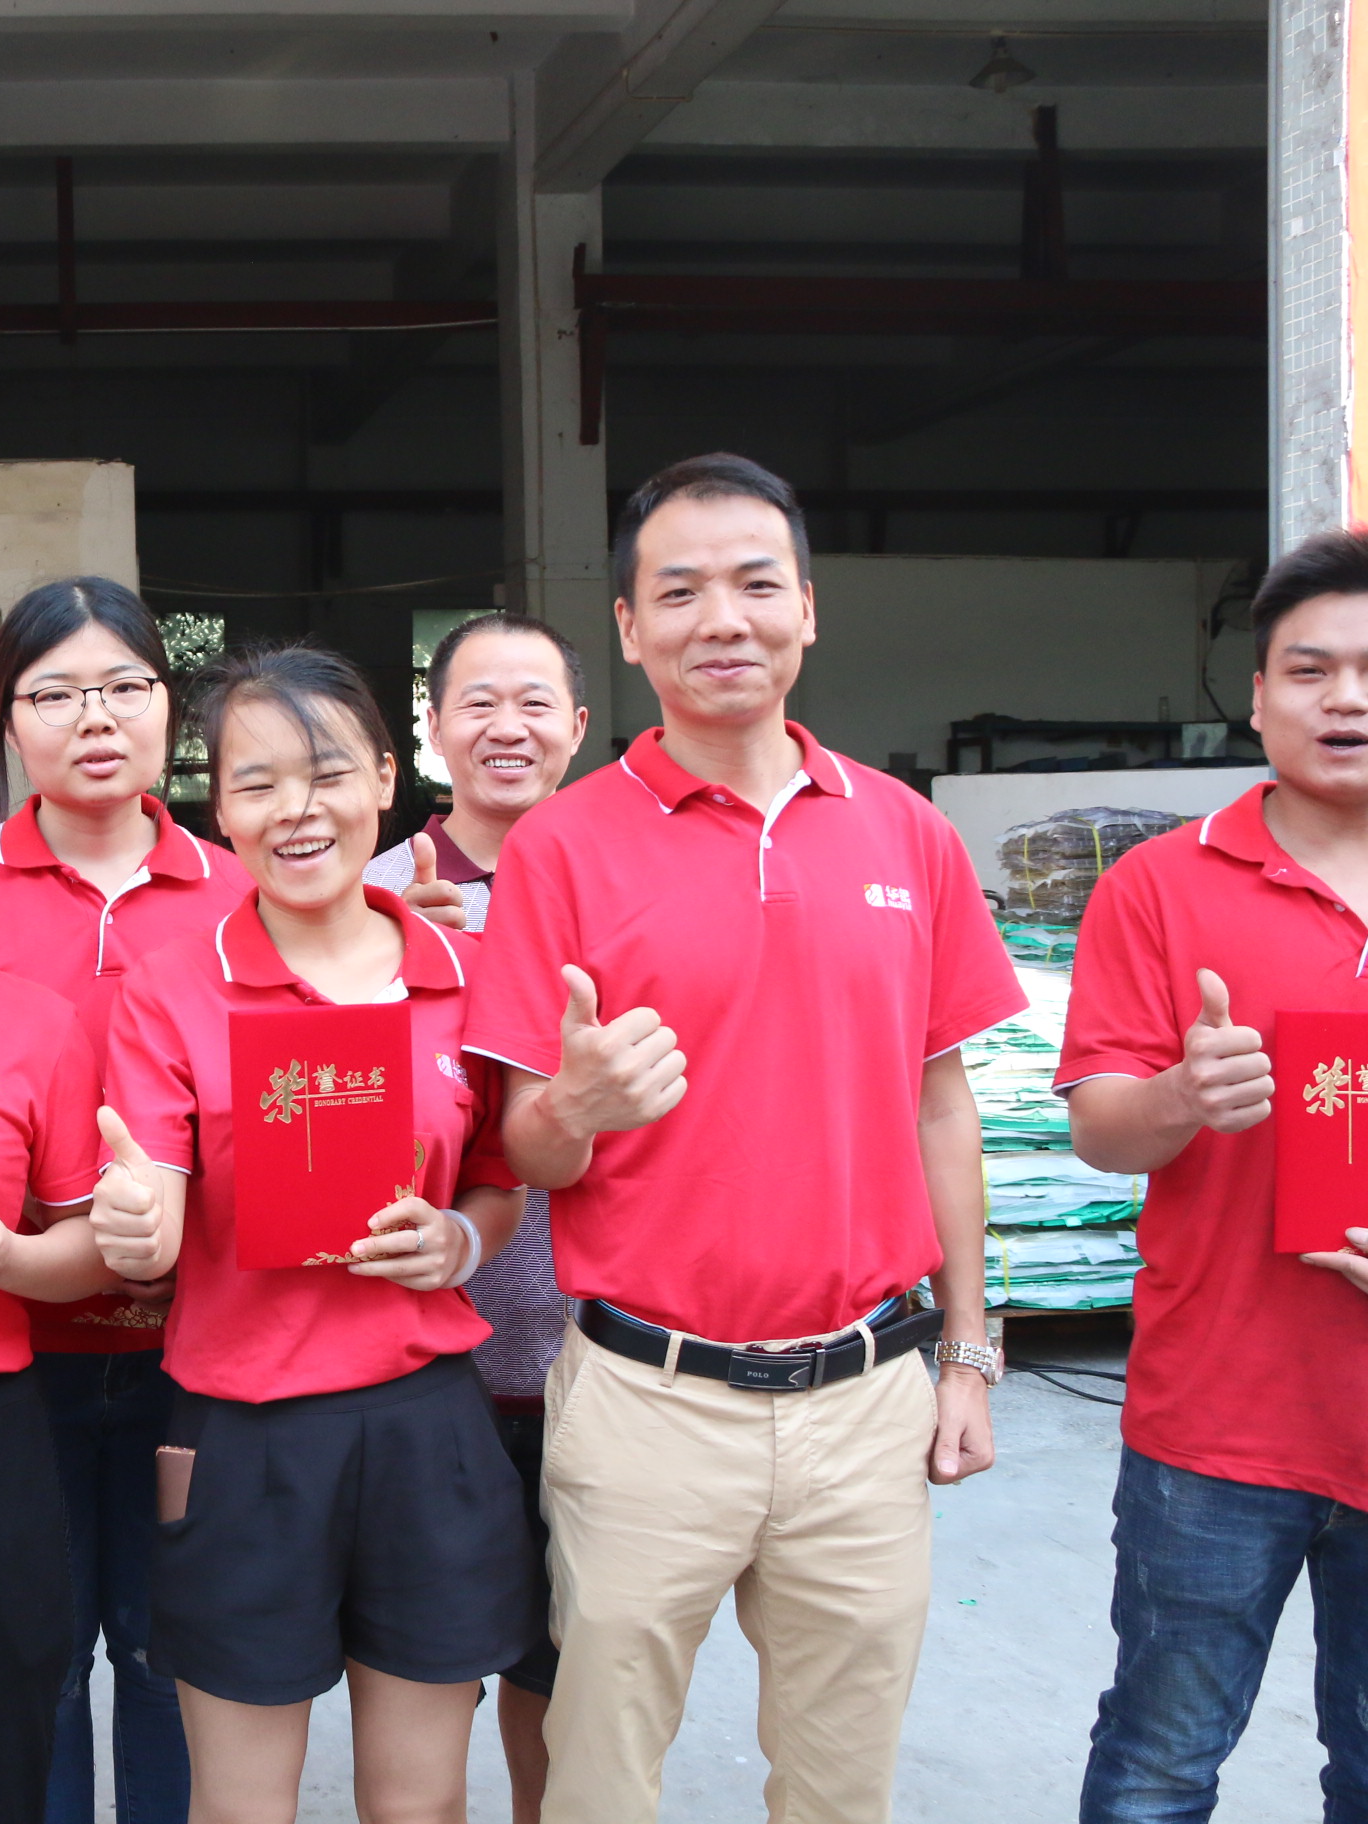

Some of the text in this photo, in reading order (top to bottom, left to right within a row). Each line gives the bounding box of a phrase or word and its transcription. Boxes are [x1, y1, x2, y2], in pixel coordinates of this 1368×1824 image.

[314, 1095, 383, 1107] HONORARY CREDENTIAL
[747, 1370, 769, 1379] POLO
